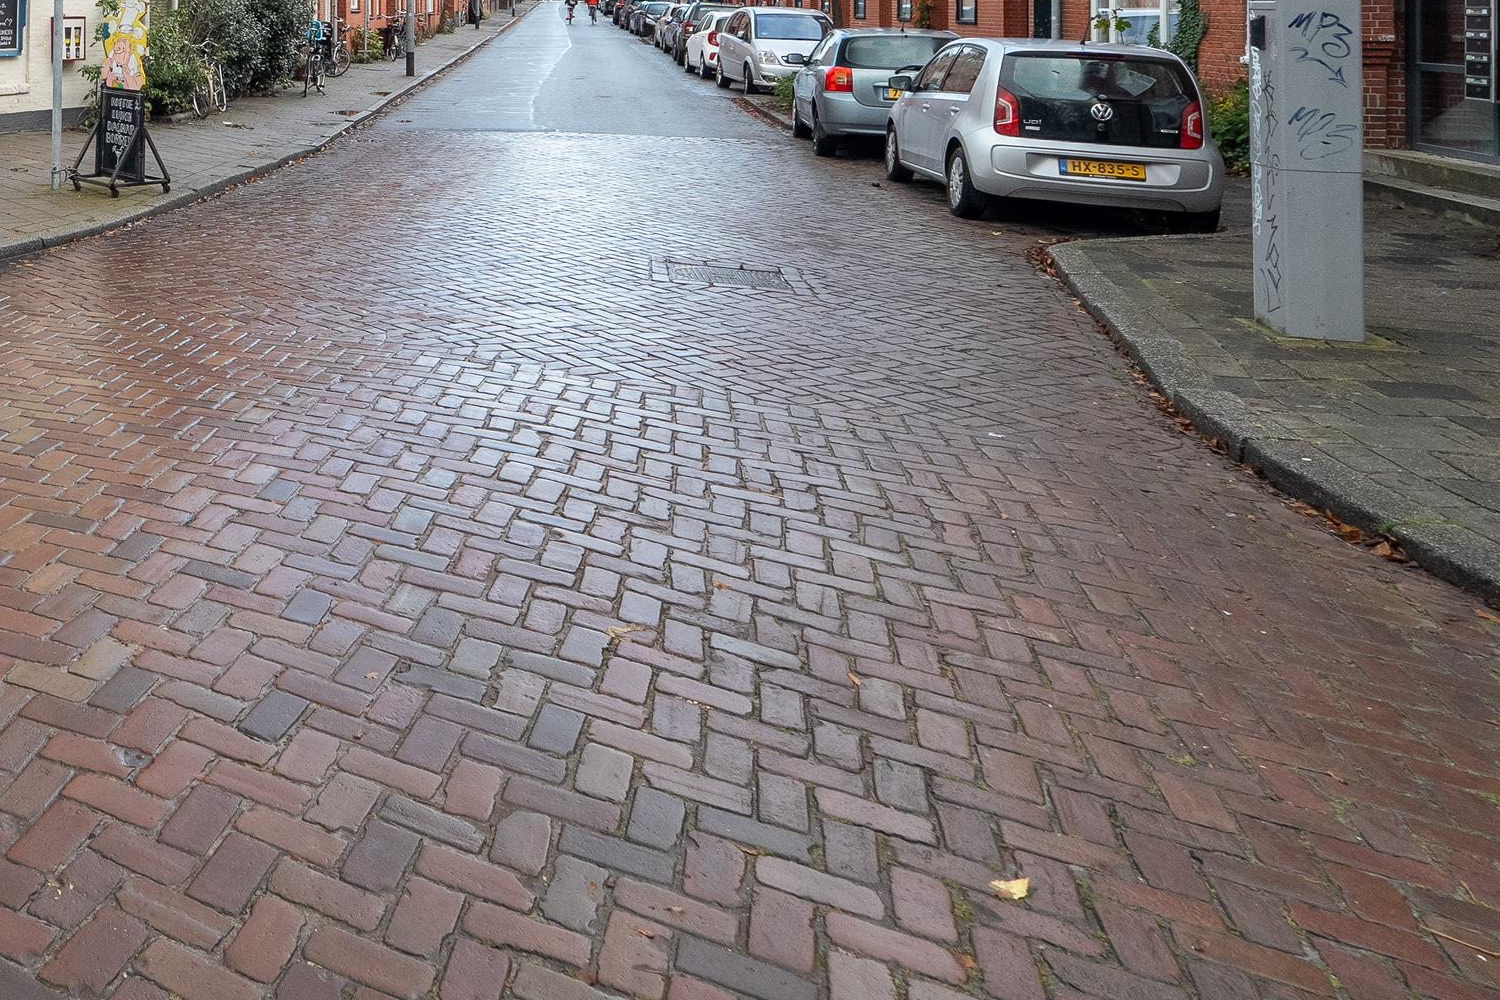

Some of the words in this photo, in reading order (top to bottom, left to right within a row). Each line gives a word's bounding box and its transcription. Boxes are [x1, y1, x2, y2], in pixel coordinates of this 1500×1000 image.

[111, 97, 133, 109] KOFFIE
[112, 109, 132, 122] LUNCH
[1072, 161, 1140, 176] HX-835-S
